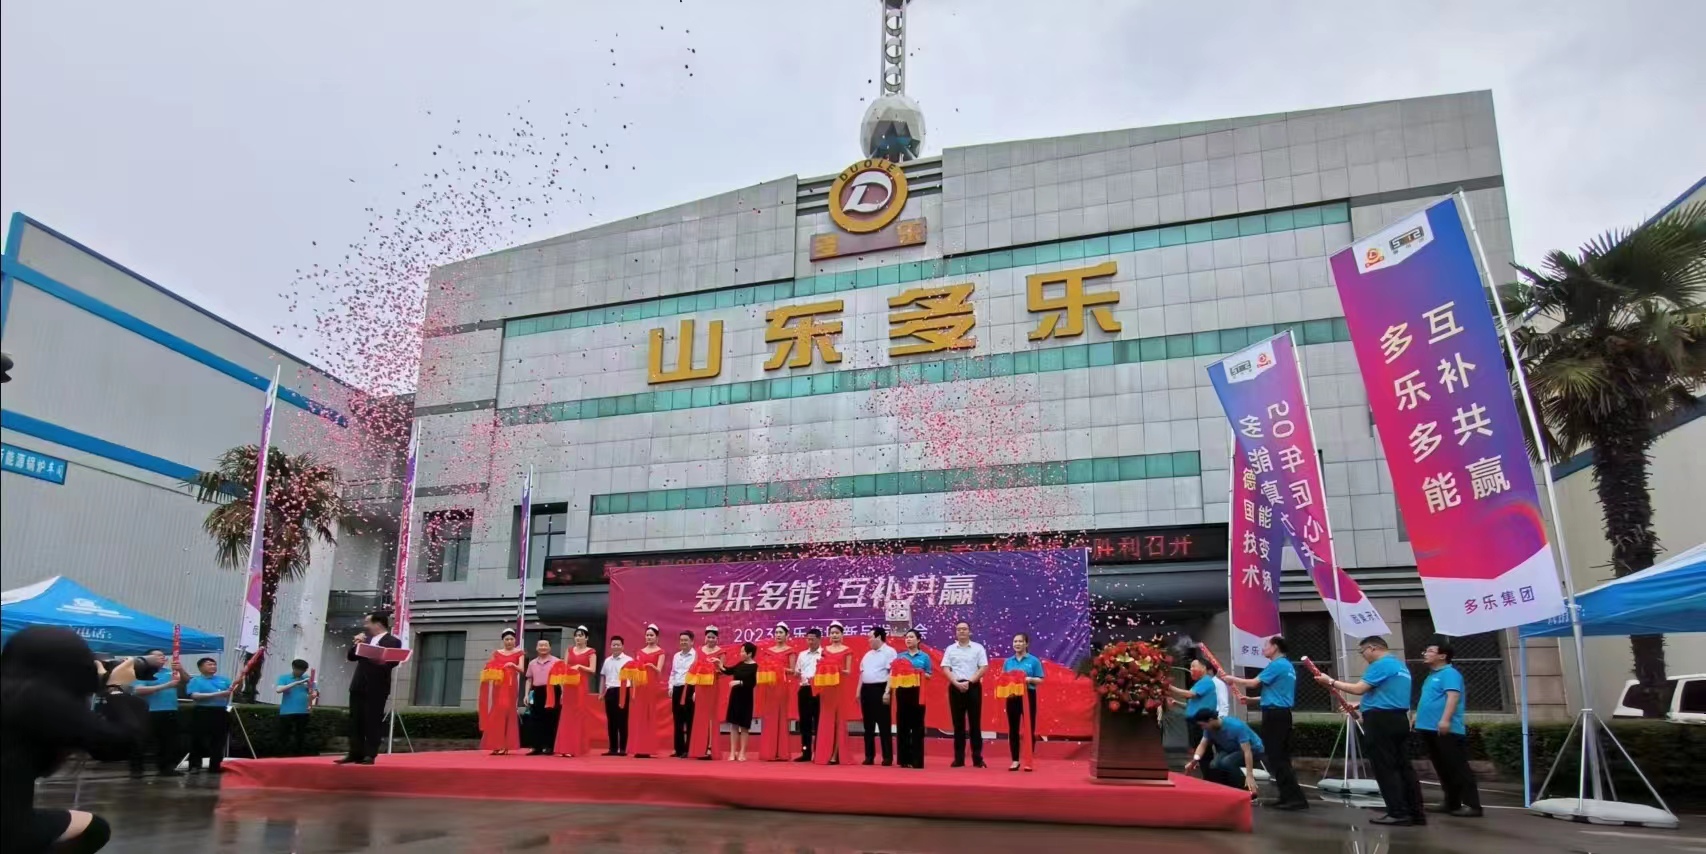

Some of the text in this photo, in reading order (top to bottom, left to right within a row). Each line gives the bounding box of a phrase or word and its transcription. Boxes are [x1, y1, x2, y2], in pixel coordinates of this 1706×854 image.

[839, 160, 896, 182] DUOLE
[648, 261, 1121, 384] 山东多乐
[1380, 322, 1461, 514] 多乐多能
[1422, 301, 1510, 500] 互补共赢
[1242, 467, 1259, 589] 德国技术
[1464, 585, 1535, 614] 多乐集团
